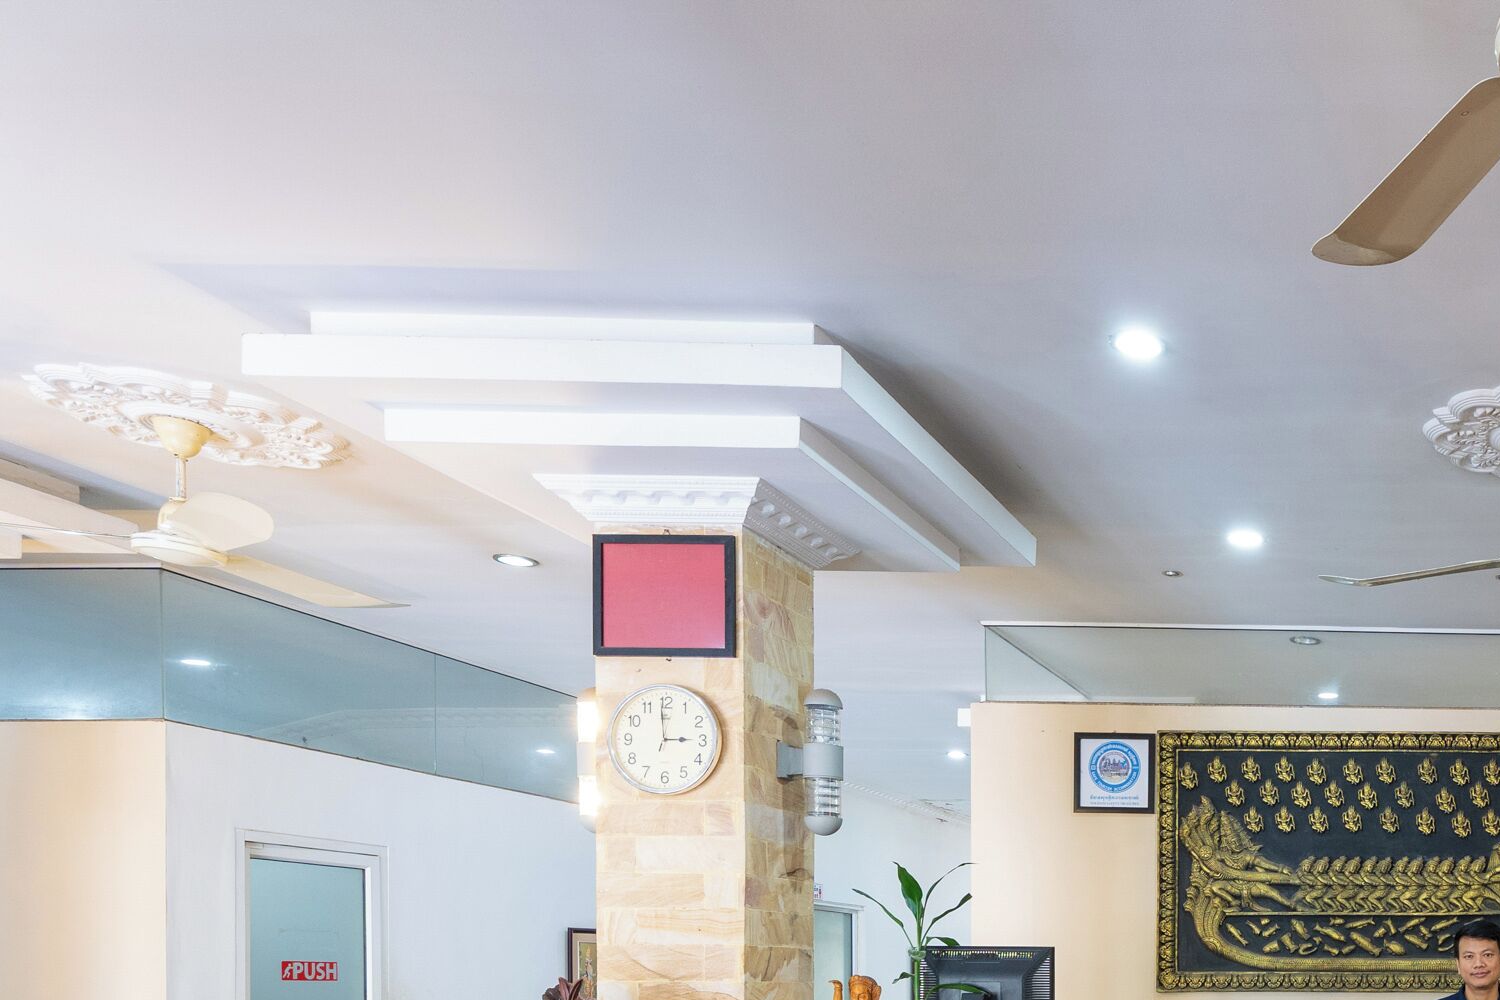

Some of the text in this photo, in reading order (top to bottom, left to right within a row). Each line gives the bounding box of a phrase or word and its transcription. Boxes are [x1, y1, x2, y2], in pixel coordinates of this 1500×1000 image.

[642, 701, 652, 714] 11
[660, 696, 673, 709] 12
[682, 702, 687, 714] 1
[628, 714, 641, 728] 10
[694, 716, 704, 728] 2
[624, 732, 633, 746] 9
[698, 734, 708, 747] 3
[628, 752, 637, 765] 8
[694, 753, 703, 766] 4
[642, 766, 651, 778] 7
[660, 771, 670, 784] 6
[680, 766, 688, 779] 5
[293, 962, 337, 980] PUSH
